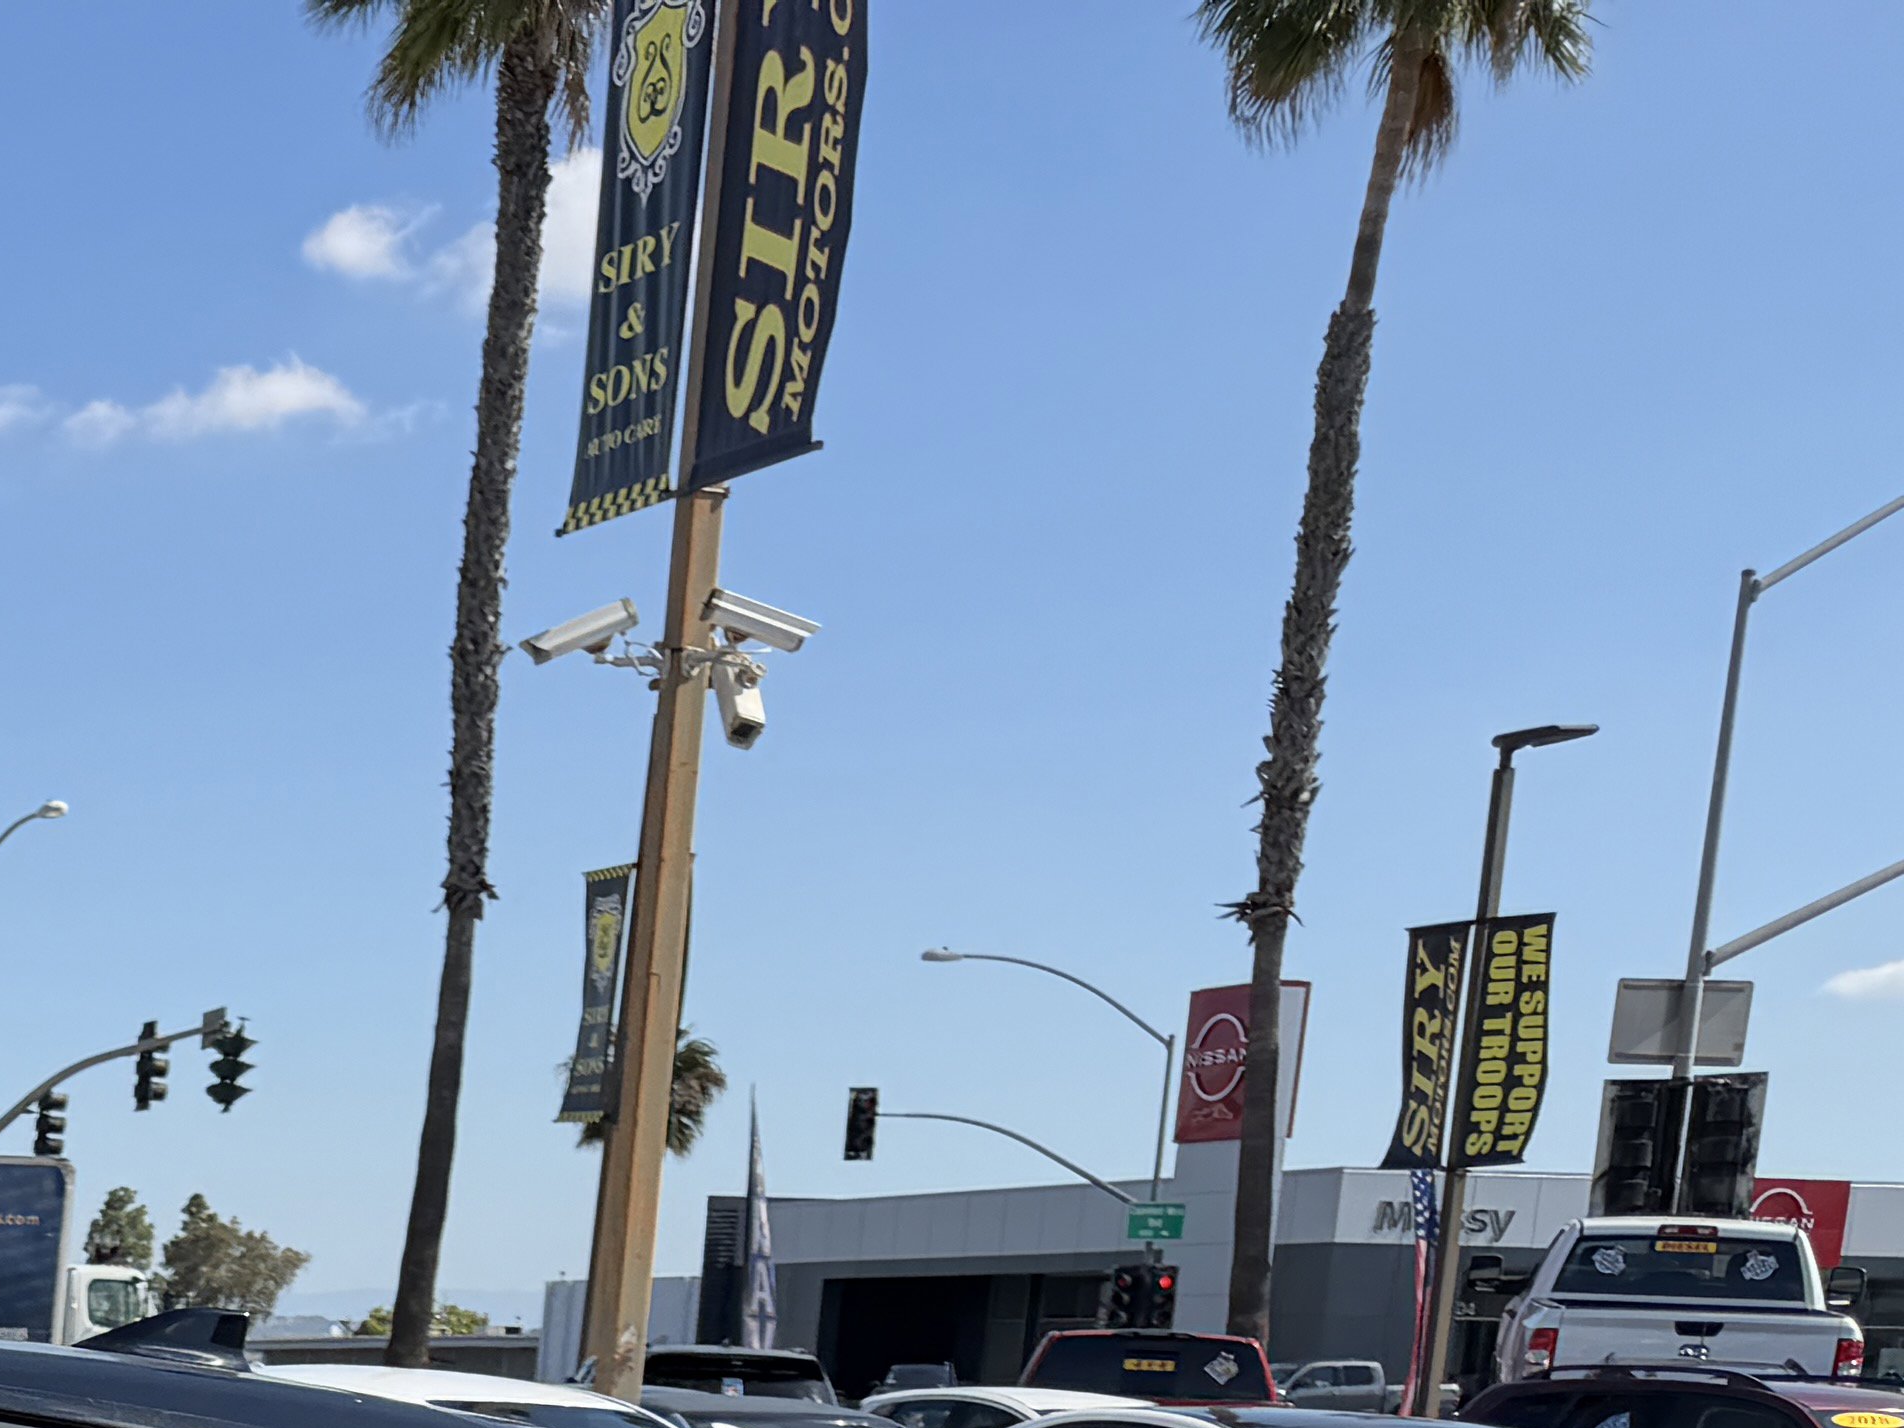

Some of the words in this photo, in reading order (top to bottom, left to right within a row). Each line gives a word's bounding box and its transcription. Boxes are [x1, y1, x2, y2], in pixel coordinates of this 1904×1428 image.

[598, 221, 680, 294] SIRY
[618, 301, 645, 340] &
[587, 346, 669, 415] SONS
[1485, 930, 1518, 1006] OUR
[1521, 923, 1549, 984] WE
[1402, 938, 1446, 1158] SIRY
[1465, 1012, 1513, 1157] TROOPS
[1496, 990, 1546, 1156] SUPPORT
[1373, 1200, 1516, 1244] Msy
